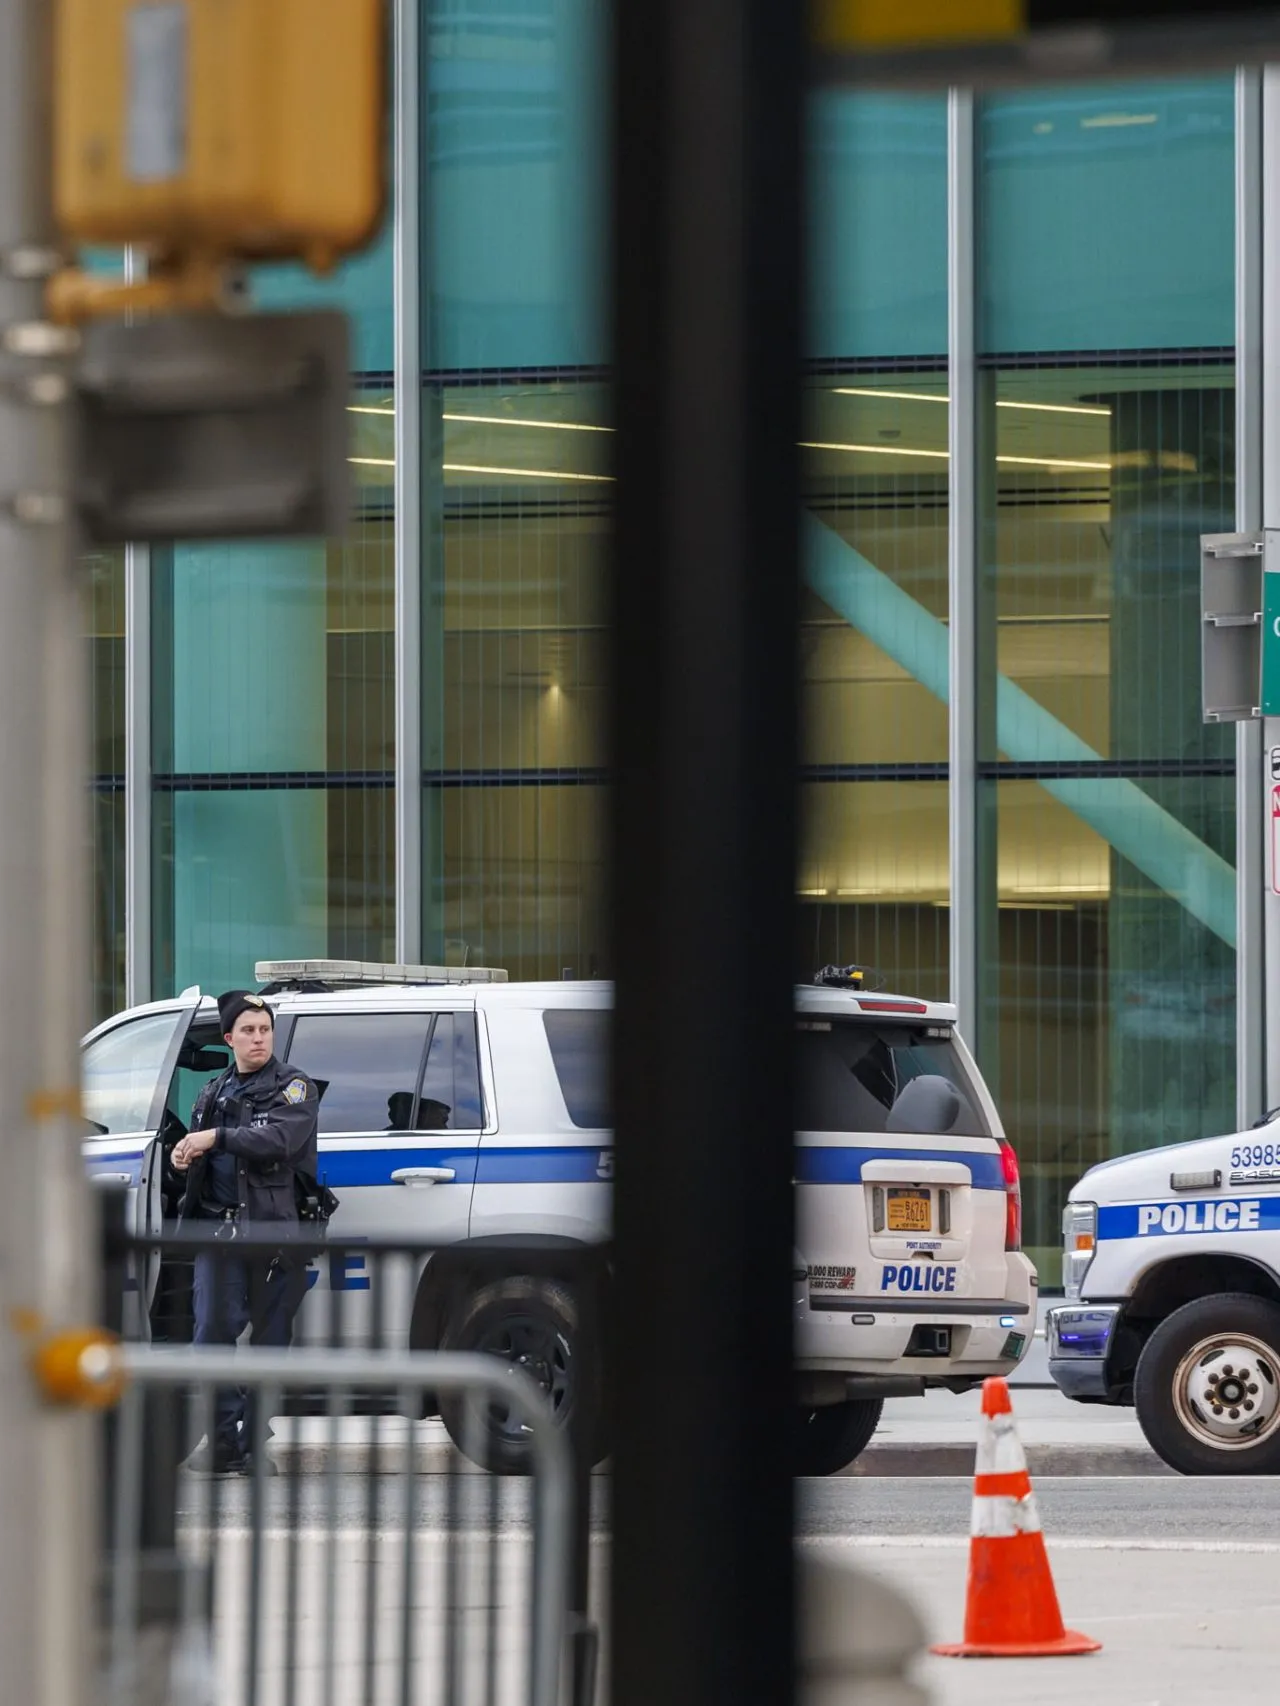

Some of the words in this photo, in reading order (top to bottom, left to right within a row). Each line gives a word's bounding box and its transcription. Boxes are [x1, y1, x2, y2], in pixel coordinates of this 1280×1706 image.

[1137, 1200, 1261, 1235] POLICE
[827, 1266, 856, 1278] REWARD
[880, 1265, 957, 1292] POLICE
